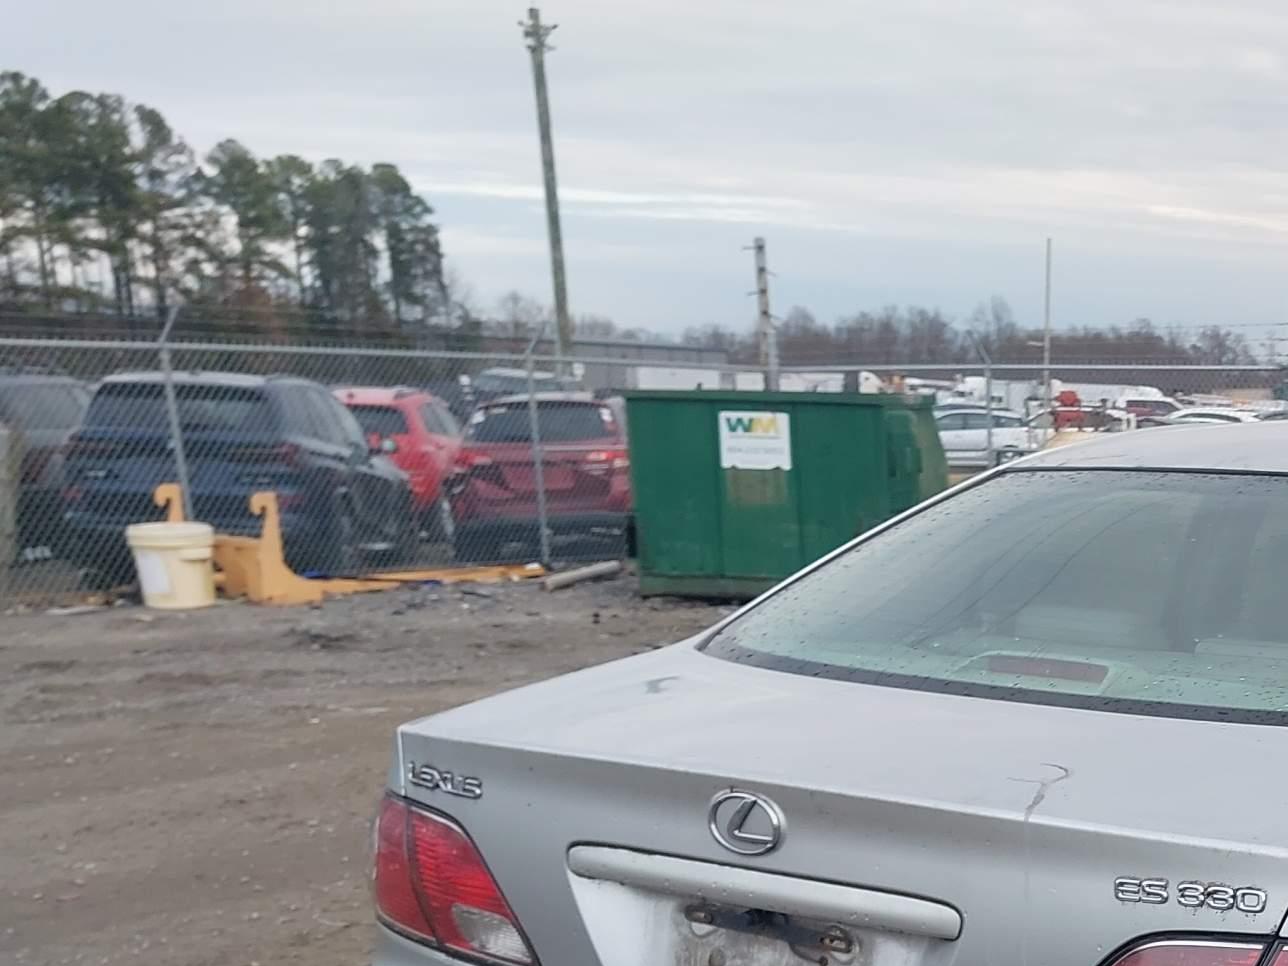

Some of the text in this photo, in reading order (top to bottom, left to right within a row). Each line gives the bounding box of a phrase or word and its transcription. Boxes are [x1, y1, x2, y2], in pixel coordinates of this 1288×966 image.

[725, 417, 777, 433] WM
[407, 761, 483, 799] LEXUS
[1114, 877, 1268, 913] ES 330
